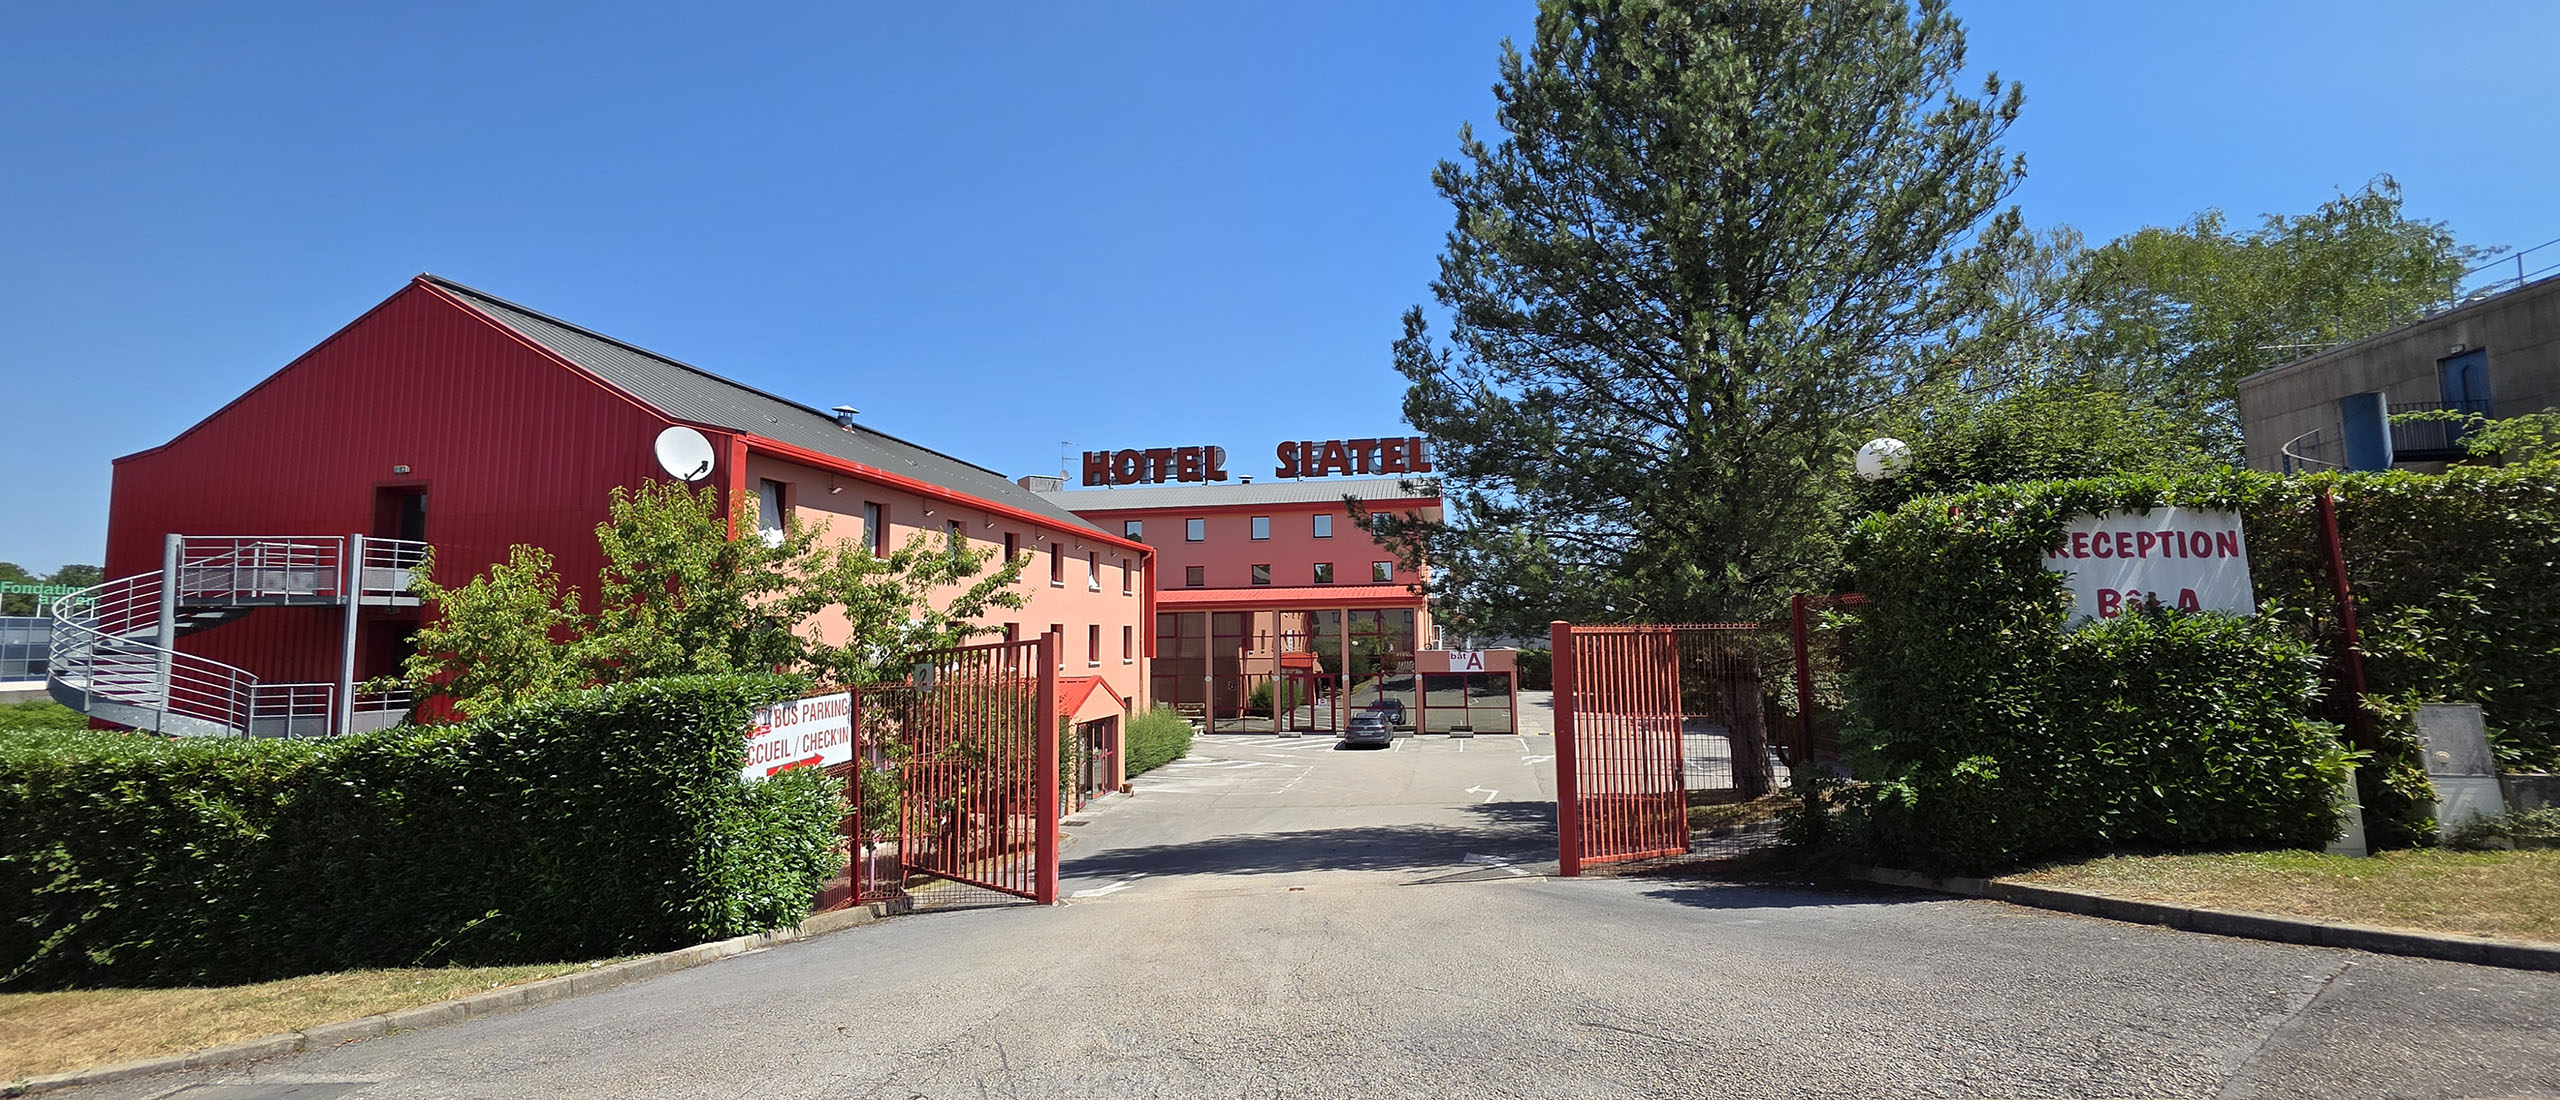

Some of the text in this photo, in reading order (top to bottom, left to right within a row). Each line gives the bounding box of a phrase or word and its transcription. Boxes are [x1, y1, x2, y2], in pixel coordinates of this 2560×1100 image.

[1083, 437, 1432, 487] HOTEL SIATEL
[2178, 588, 2201, 612] A
[1466, 652, 1483, 670] A
[774, 698, 848, 728] BUS PARKING
[740, 739, 791, 767] CCUEIL
